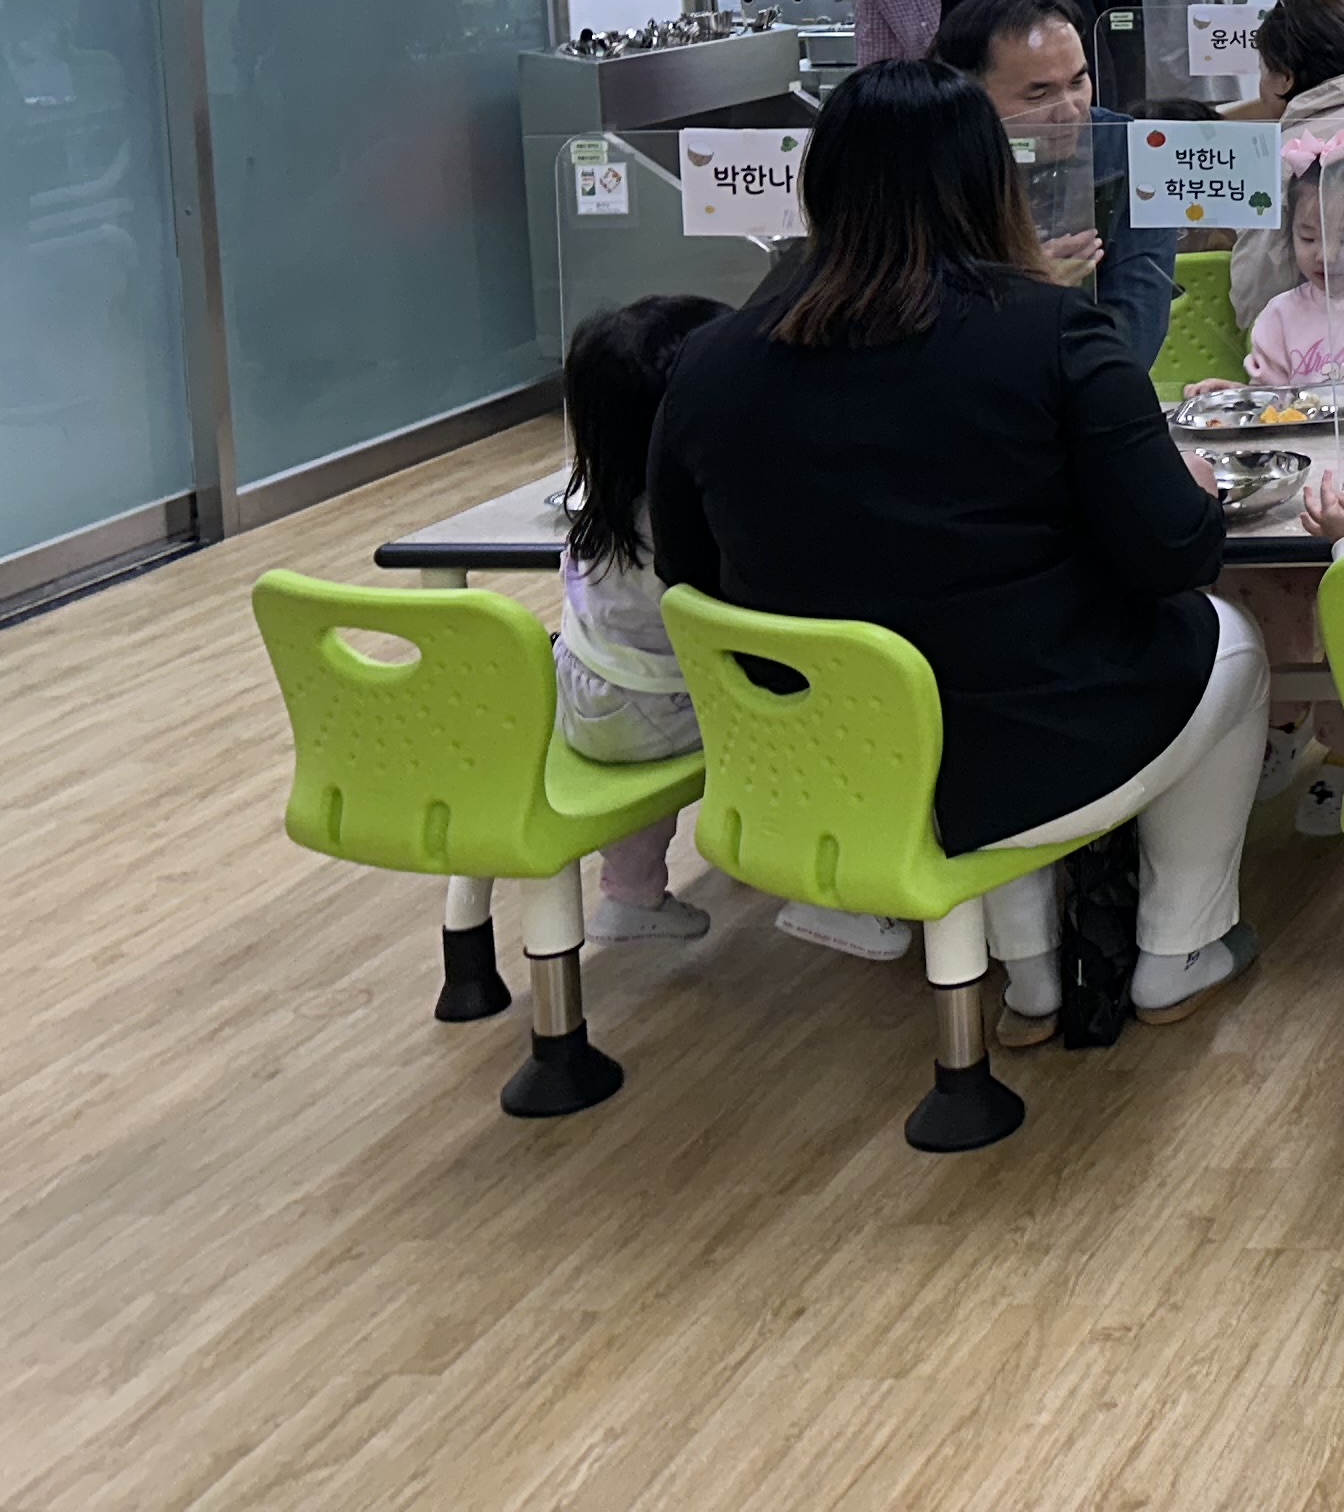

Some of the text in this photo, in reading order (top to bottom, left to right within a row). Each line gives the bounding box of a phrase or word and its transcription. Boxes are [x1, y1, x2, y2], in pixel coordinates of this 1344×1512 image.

[1175, 148, 1236, 170] 박한나
[713, 164, 794, 195] 박한나
[1165, 178, 1245, 201] 학부모님
